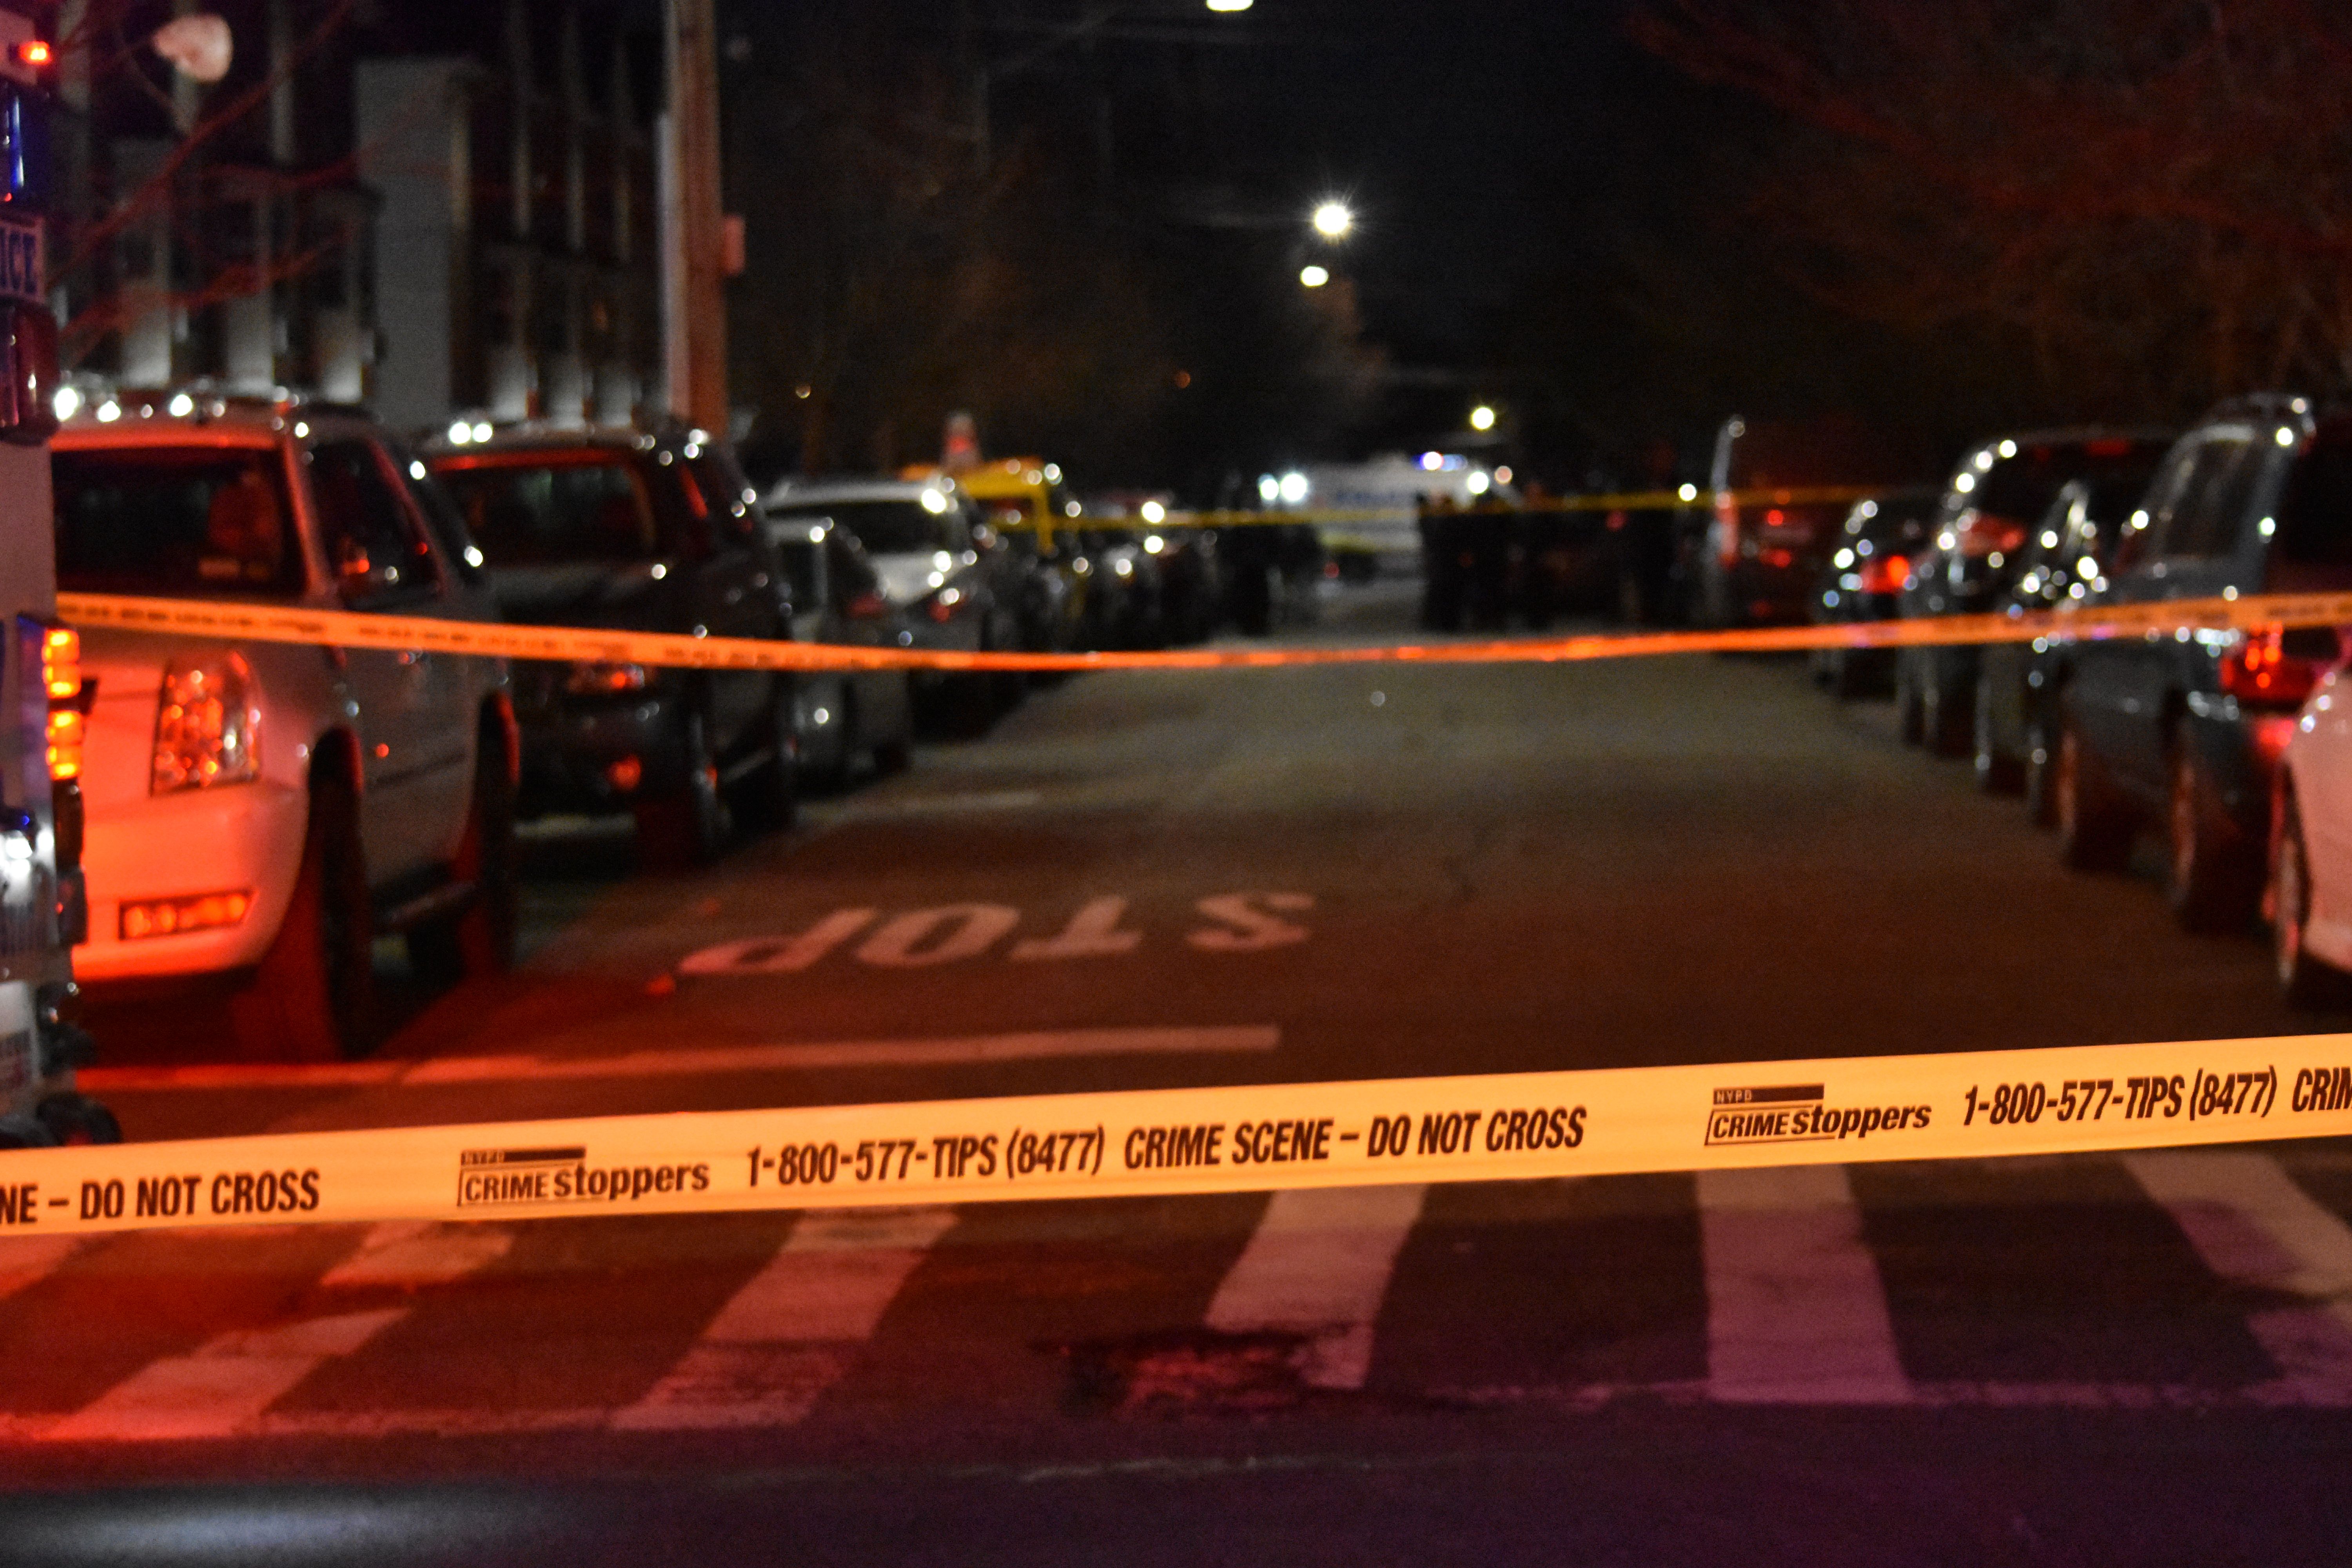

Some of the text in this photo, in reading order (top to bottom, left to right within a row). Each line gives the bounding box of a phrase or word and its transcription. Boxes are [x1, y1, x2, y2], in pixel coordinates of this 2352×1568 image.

[678, 891, 1316, 974] STOP
[1715, 1089, 1752, 1103] NYPD
[1964, 1075, 2185, 1126] 1-800-577-TIPS
[2189, 1065, 2277, 1121] (8477)
[748, 1135, 999, 1187] 1-800-577-TIPS
[1006, 1125, 1105, 1179] (8477)
[1125, 1125, 1225, 1170] CRIME
[1232, 1119, 1334, 1164] SCENE
[1367, 1115, 1412, 1157] DO
[1417, 1112, 1481, 1155] NOT
[1486, 1107, 1587, 1152] CROSS
[0, 1184, 38, 1225] NE
[80, 1180, 125, 1220] DO
[136, 1176, 202, 1217] NOT
[211, 1169, 319, 1215] CROSS
